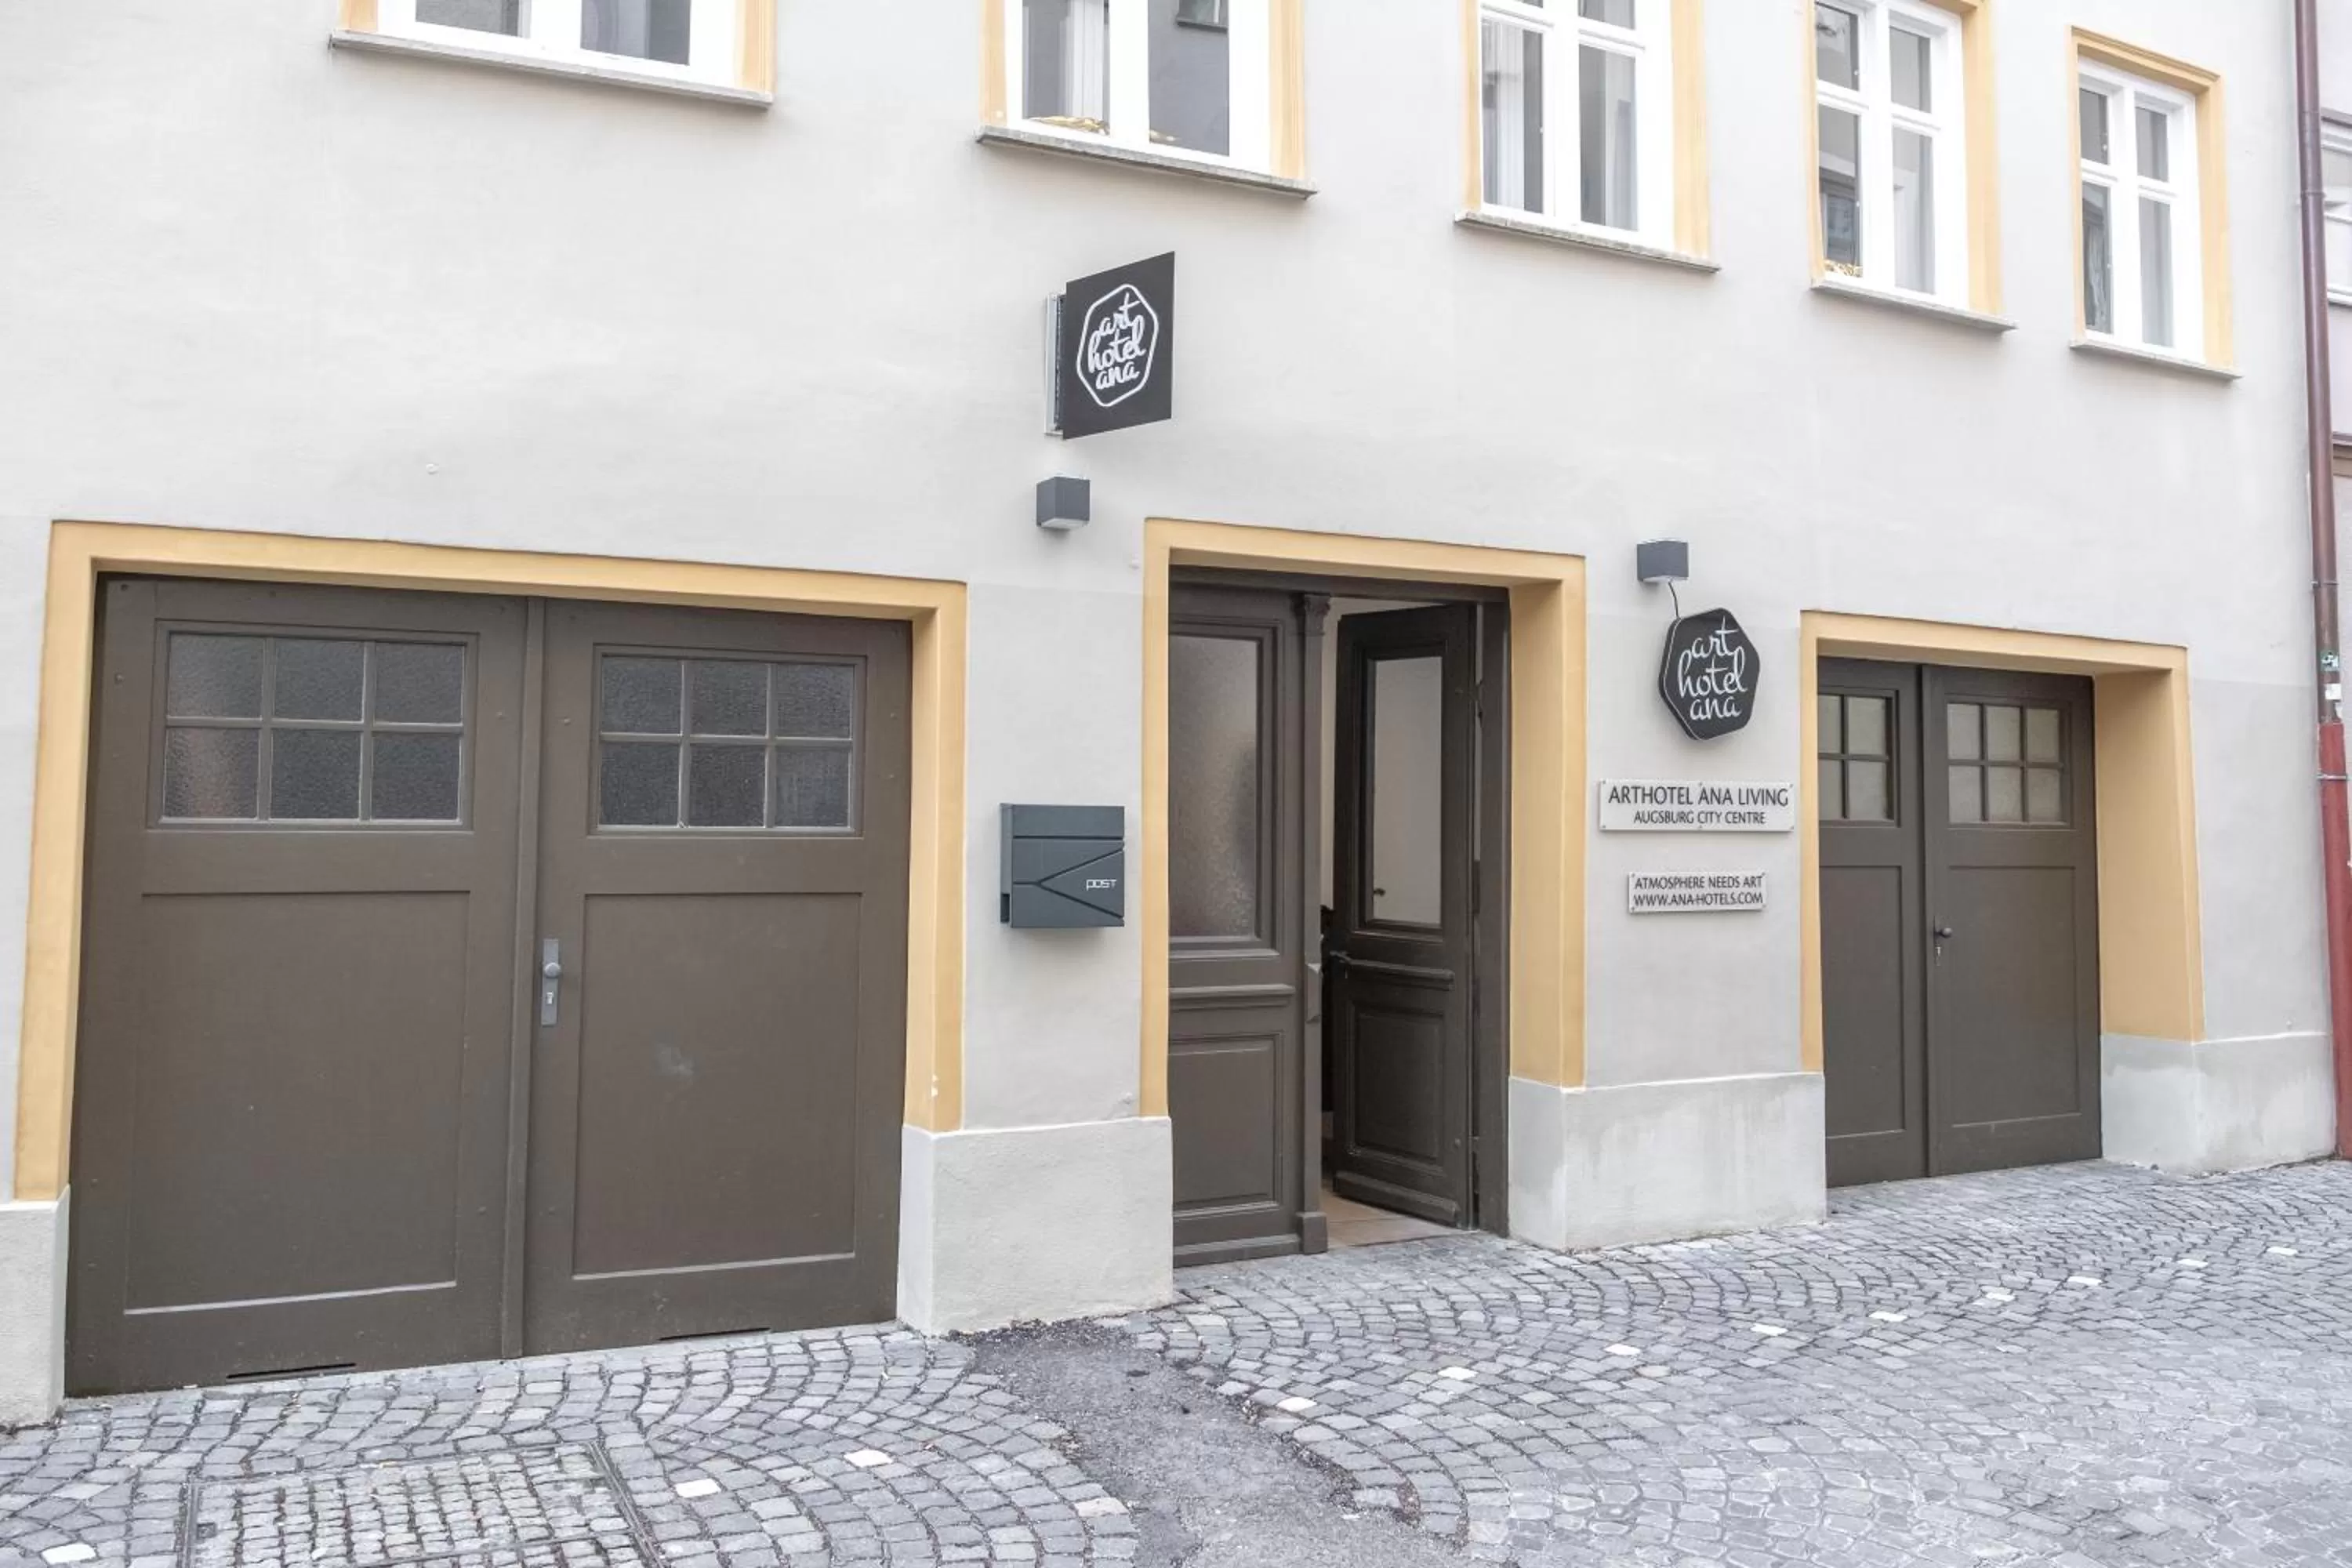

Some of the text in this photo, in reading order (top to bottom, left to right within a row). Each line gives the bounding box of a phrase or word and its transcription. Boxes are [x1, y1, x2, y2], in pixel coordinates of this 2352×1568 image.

[1099, 292, 1140, 336] art
[1087, 315, 1146, 374] hotel
[1096, 361, 1140, 390] ana
[1691, 615, 1739, 658] art
[1678, 646, 1748, 698] hotel
[1690, 696, 1742, 720] ana
[1608, 786, 1789, 807] ARTHOTEL ANA LIVING
[1633, 810, 1766, 825] AUGSBURG CITY CENTRE
[1634, 875, 1763, 890] ATMOSPHERE NEEDS ART
[1633, 891, 1763, 907] WWW.ANA-HOTELS.COM
